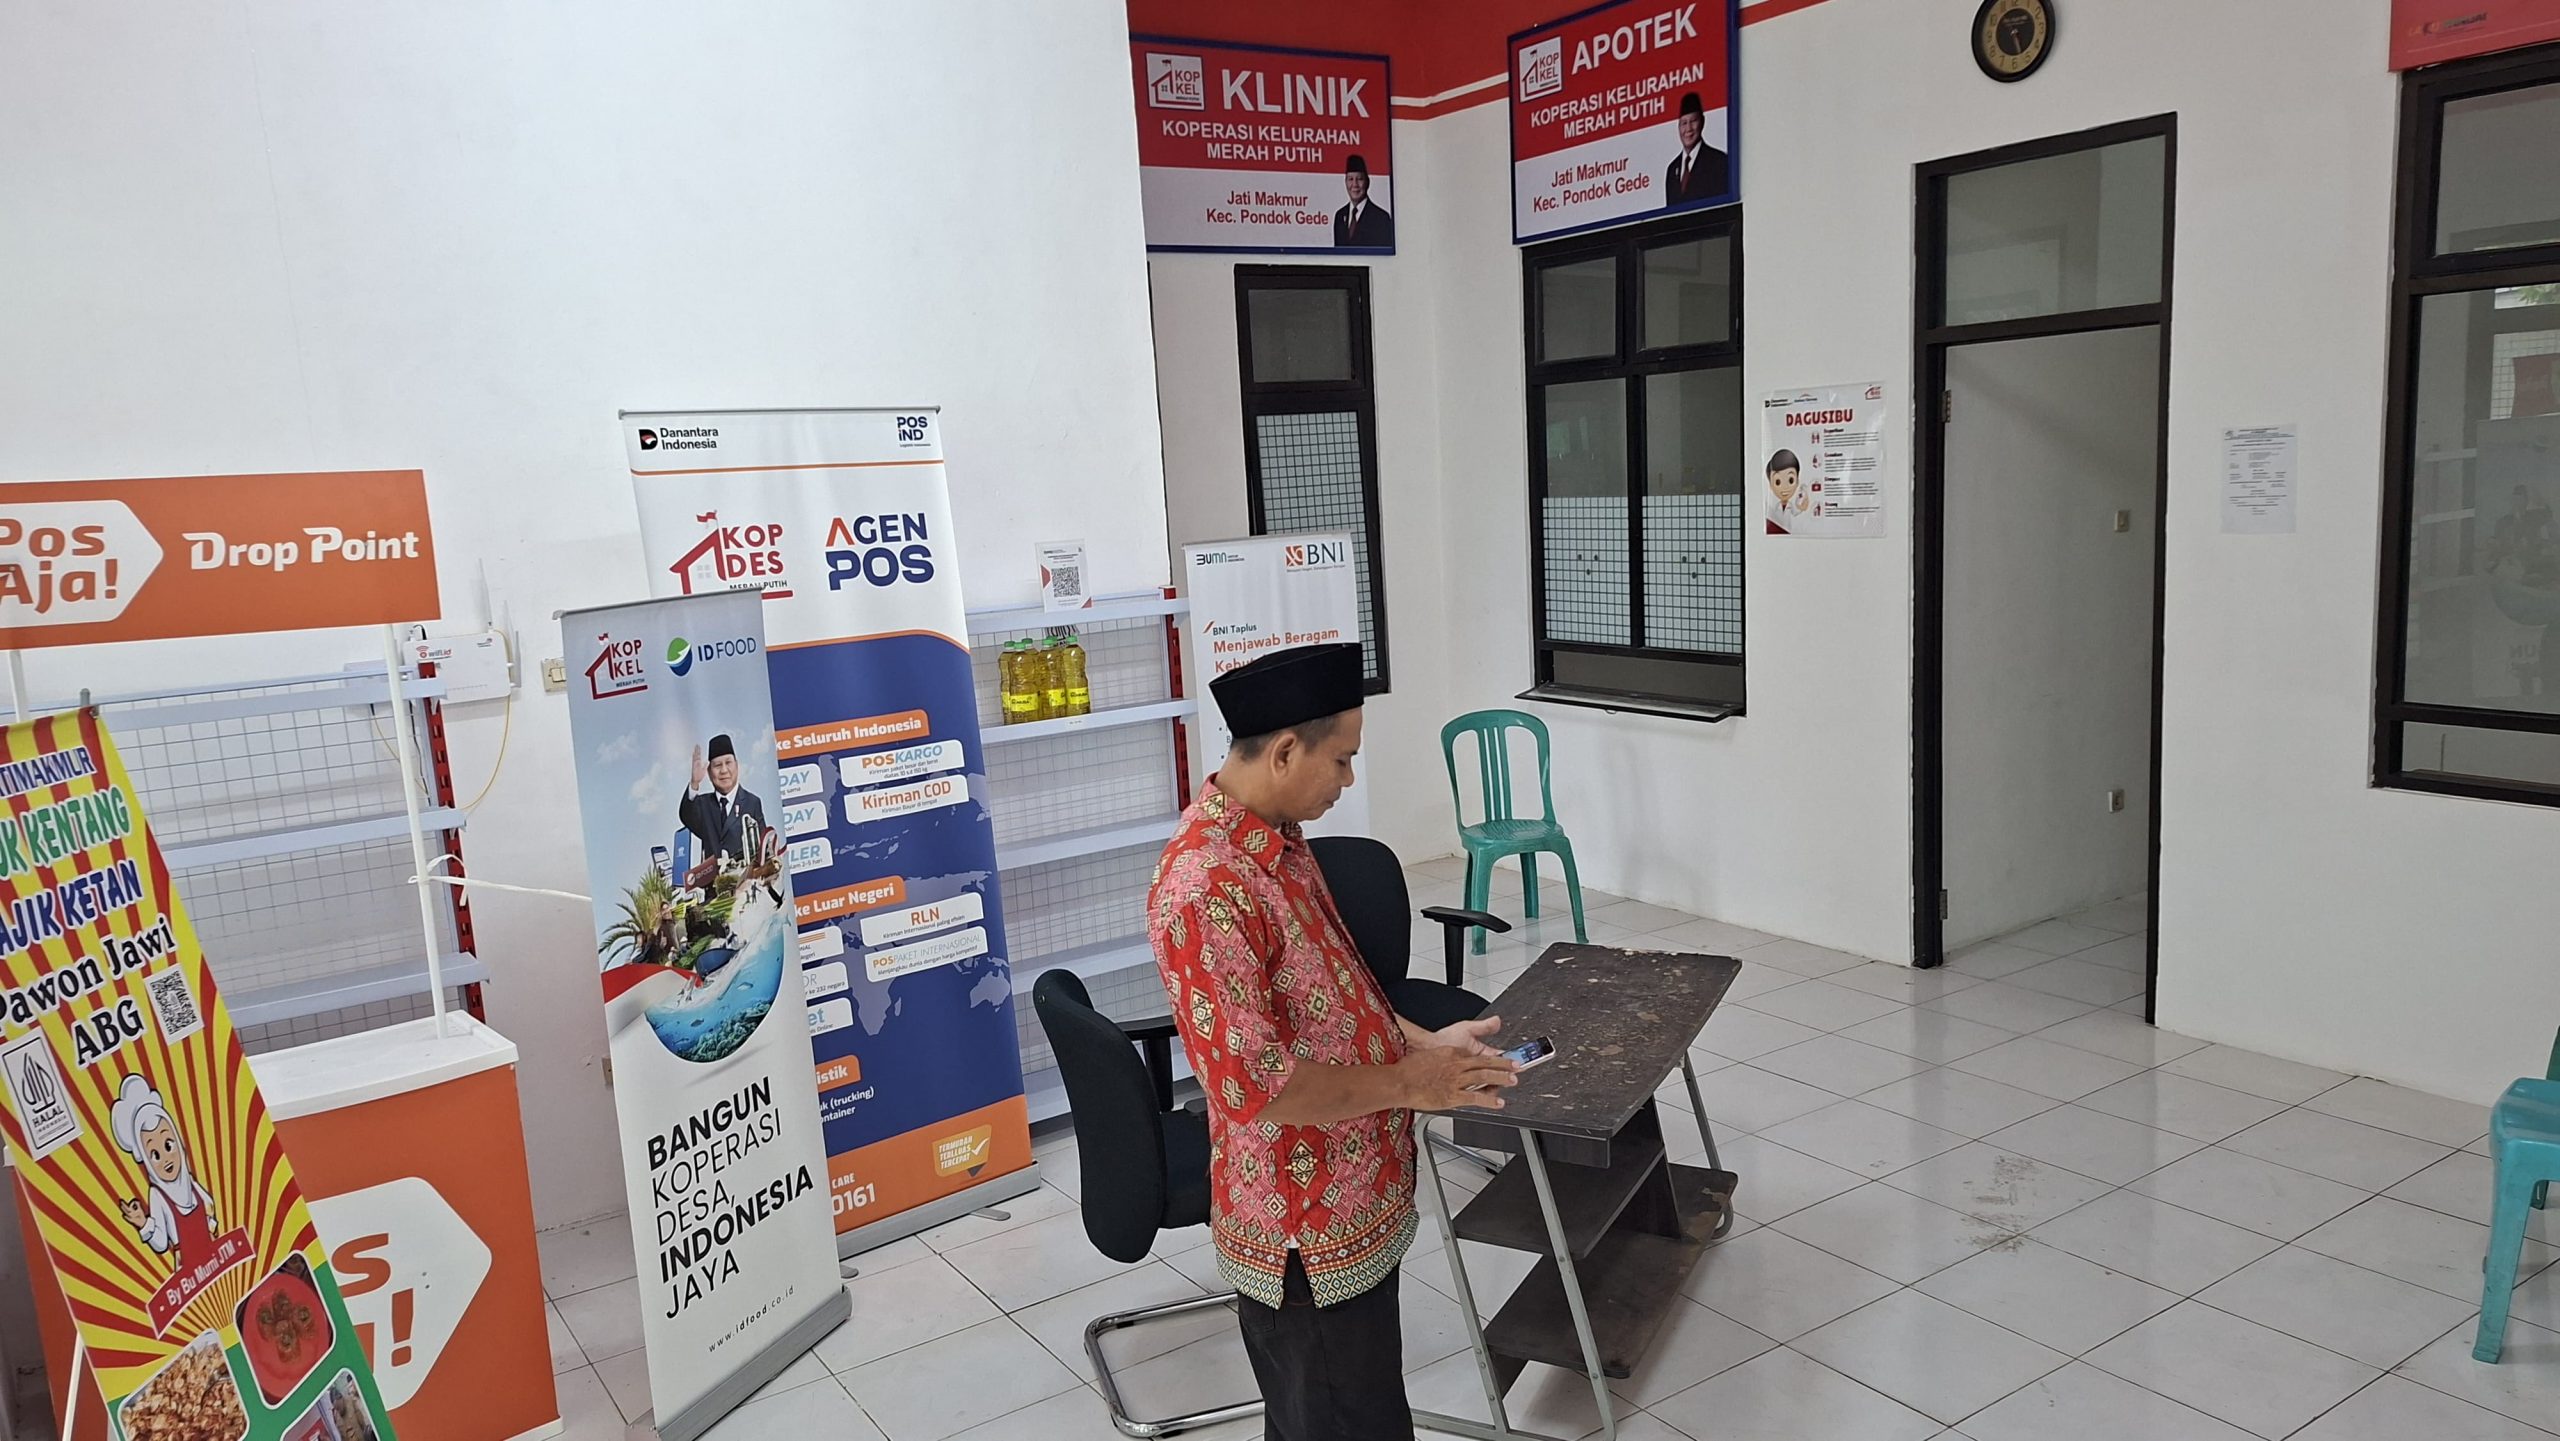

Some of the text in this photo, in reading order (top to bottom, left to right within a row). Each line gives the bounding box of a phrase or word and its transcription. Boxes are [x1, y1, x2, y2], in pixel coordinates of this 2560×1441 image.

[1571, 3, 1698, 76] APOTEK
[1540, 52, 1559, 69] KOP
[1540, 65, 1559, 82] KEL
[1175, 70, 1200, 82] KOP
[1176, 83, 1200, 95] KEL
[1221, 68, 1369, 118] KLINIK
[1530, 62, 1704, 128] KOPERASI KELURAHAN
[1563, 96, 1665, 139] MERAH PUTIH
[1162, 119, 1360, 145] KOPERASI KELURAHAN
[1207, 143, 1322, 163] MERAH PUTIH
[1551, 157, 1629, 188] Jati Makmur
[1227, 190, 1308, 207] Jati Makmur
[1533, 173, 1650, 213] Kec. Pondok Gede
[1206, 208, 1329, 225] Kec. Pondok Gede
[896, 416, 928, 428] POS
[1786, 408, 1853, 427] DAGUSIBU
[660, 426, 719, 438] Danantara
[661, 438, 718, 450] Indonesia
[722, 523, 783, 550] KOP
[826, 512, 928, 547] AGEN
[182, 526, 420, 572] Drop Point
[1307, 542, 1345, 565] BNI
[726, 550, 784, 578] DES
[825, 545, 935, 591] POS
[0, 558, 119, 614] Aja!
[763, 580, 788, 588] PUTIH
[1213, 623, 1257, 636] BNI Taplus
[1213, 629, 1339, 654] Menjawab Beragam
[611, 640, 642, 659] KOP
[613, 659, 643, 678] KEL
[794, 728, 851, 748] Seluruh
[854, 717, 922, 739] Indonesia
[861, 744, 943, 769] POSKARGO
[0, 748, 95, 796] TIMAKMUR
[862, 780, 952, 810] Kiriman COD
[23, 787, 131, 866] KENTANG
[60, 860, 143, 927] KETAN
[795, 881, 895, 917] ke Luar Negeri
[911, 906, 940, 926] RLN
[104, 917, 176, 976] Jawi
[920, 934, 982, 957] INTERNASIONAL
[71, 999, 146, 1067] ABG
[830, 1086, 875, 1111] (trucking)
[32, 1105, 65, 1128] HALAL
[648, 1075, 772, 1172] BANGUN
[651, 1107, 782, 1209] KOPERASI
[938, 1135, 973, 1154] TERMURAH
[941, 1152, 970, 1170] TERCEPAT
[832, 1173, 856, 1189] CARE
[656, 1178, 736, 1247] DESA,
[832, 1183, 876, 1217] 0161
[659, 1164, 815, 1284] INDONESIA
[165, 1286, 182, 1306] By
[180, 1276, 197, 1296] Bu
[217, 1239, 236, 1265] JTM
[665, 1250, 741, 1320] JAYA
[708, 1284, 795, 1353] www.idfood.co.id
